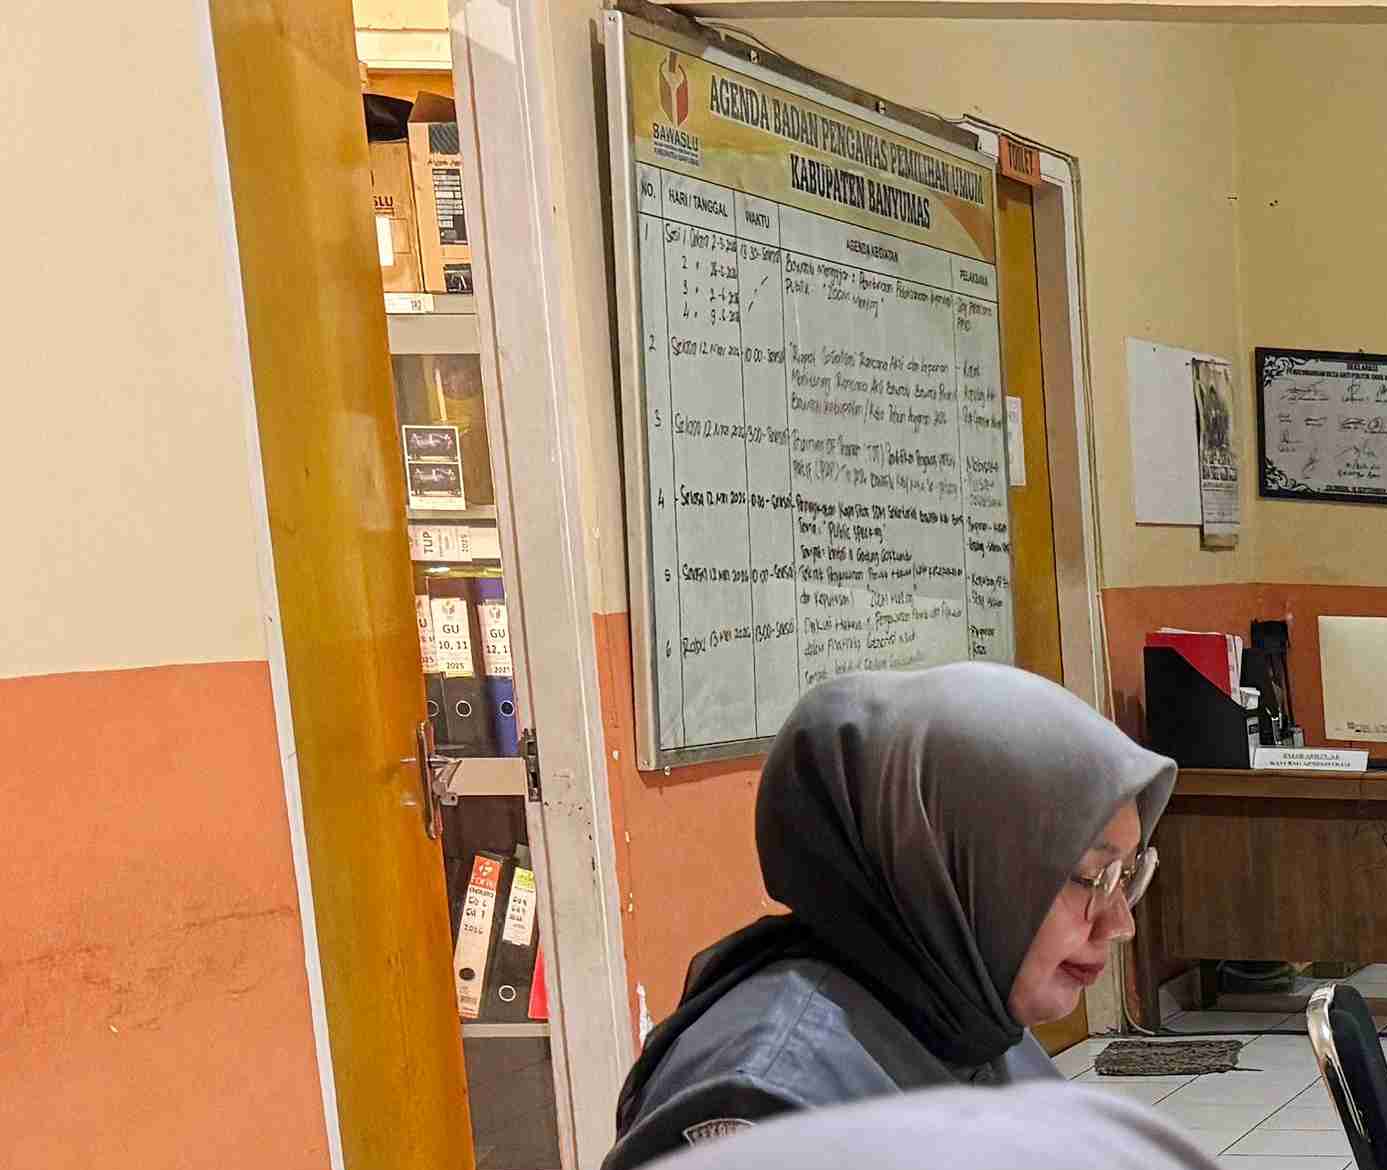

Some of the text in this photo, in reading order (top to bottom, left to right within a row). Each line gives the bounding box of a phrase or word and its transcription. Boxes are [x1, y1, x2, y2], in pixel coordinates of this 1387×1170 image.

[710, 74, 770, 131] AGENDA
[773, 99, 818, 150] BADAN
[822, 117, 888, 172] PENGAWAS
[653, 122, 699, 151] BAWASLU
[791, 152, 931, 230] KABUPATEN BANYUMAS
[693, 195, 729, 218] TANGGAL
[744, 210, 770, 229] WAKTU
[423, 531, 434, 554] TUP
[442, 623, 460, 635] GU
